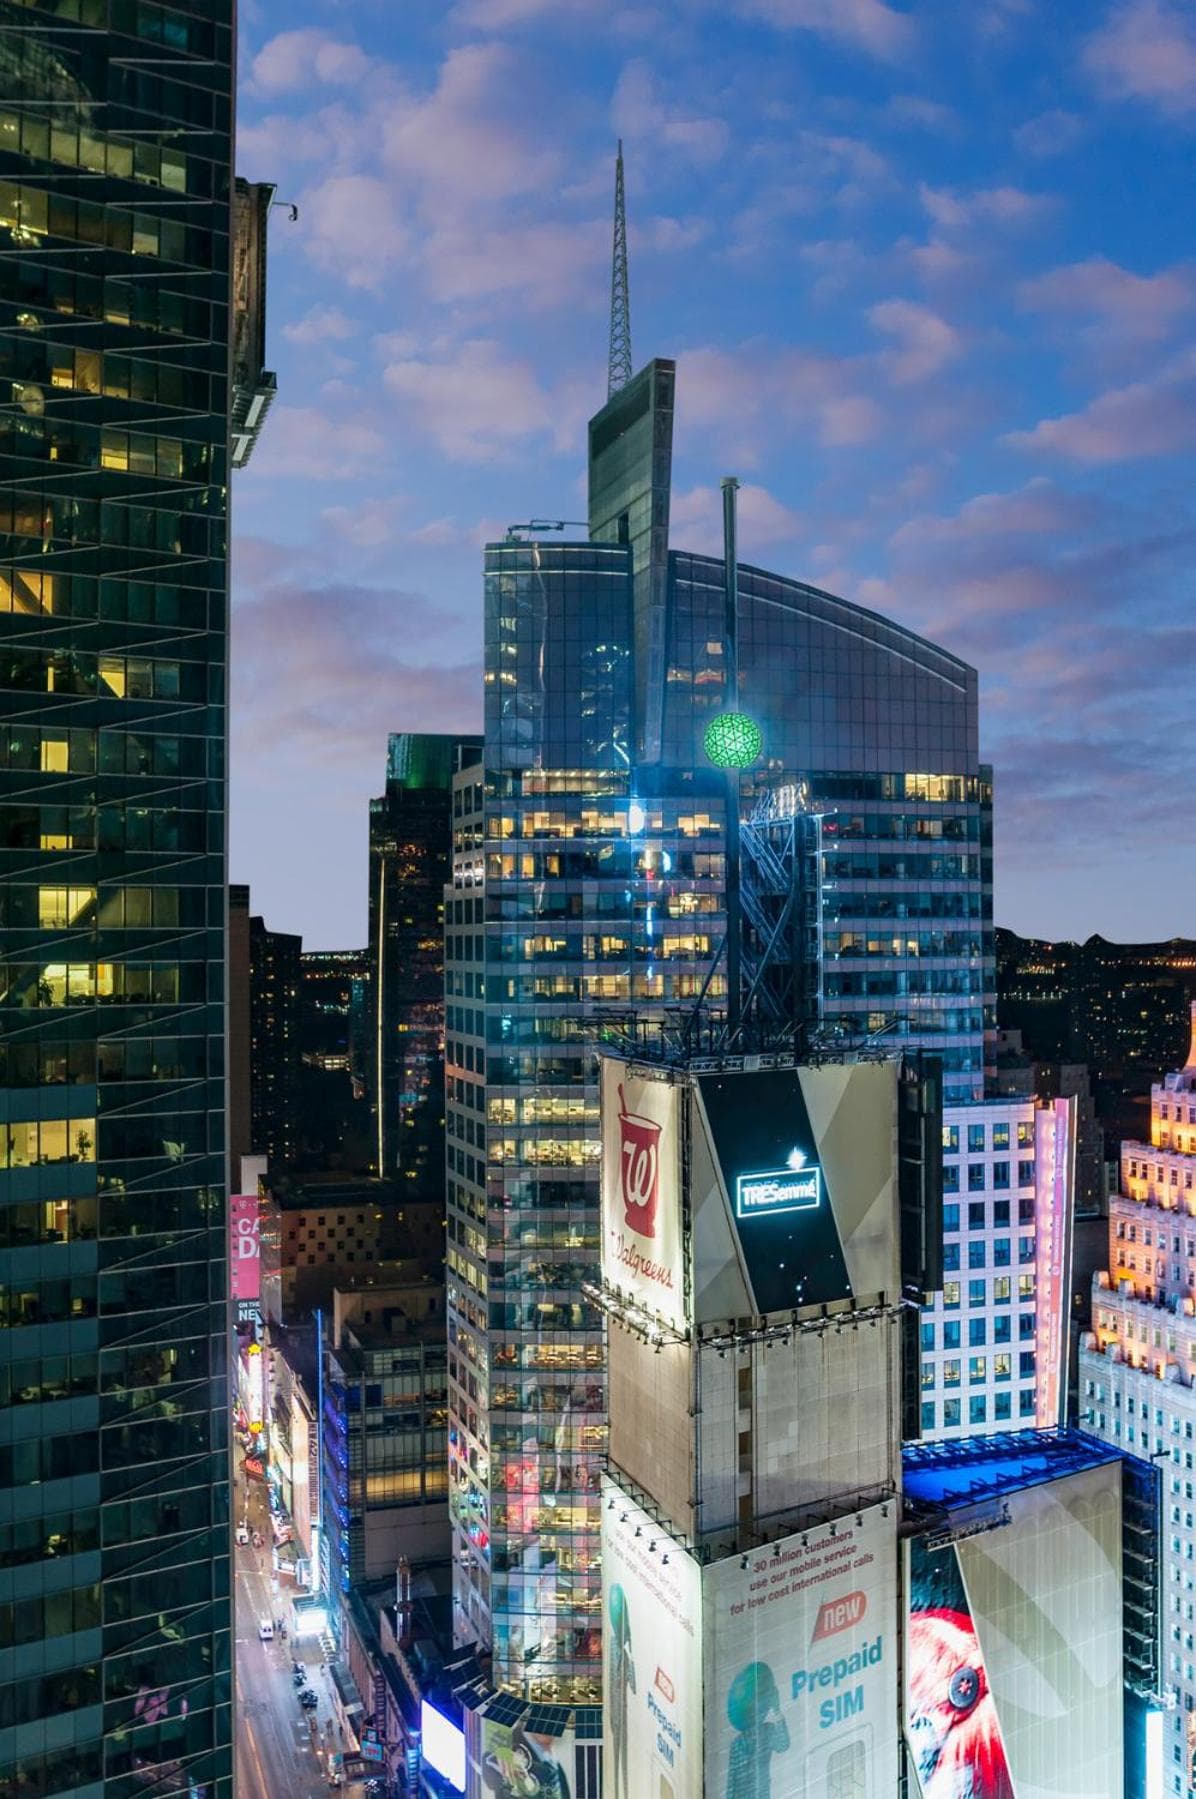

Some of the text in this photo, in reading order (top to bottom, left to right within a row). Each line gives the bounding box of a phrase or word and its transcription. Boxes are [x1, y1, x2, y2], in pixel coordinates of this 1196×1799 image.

[610, 1231, 673, 1288] Walgreens
[750, 1545, 857, 1592] use our mobile service
[753, 1530, 853, 1573] 30 million customers
[730, 1553, 874, 1616] for low cost international calls
[823, 1596, 862, 1631] new
[791, 1635, 882, 1700] Prepaid
[819, 1684, 864, 1728] SIM
